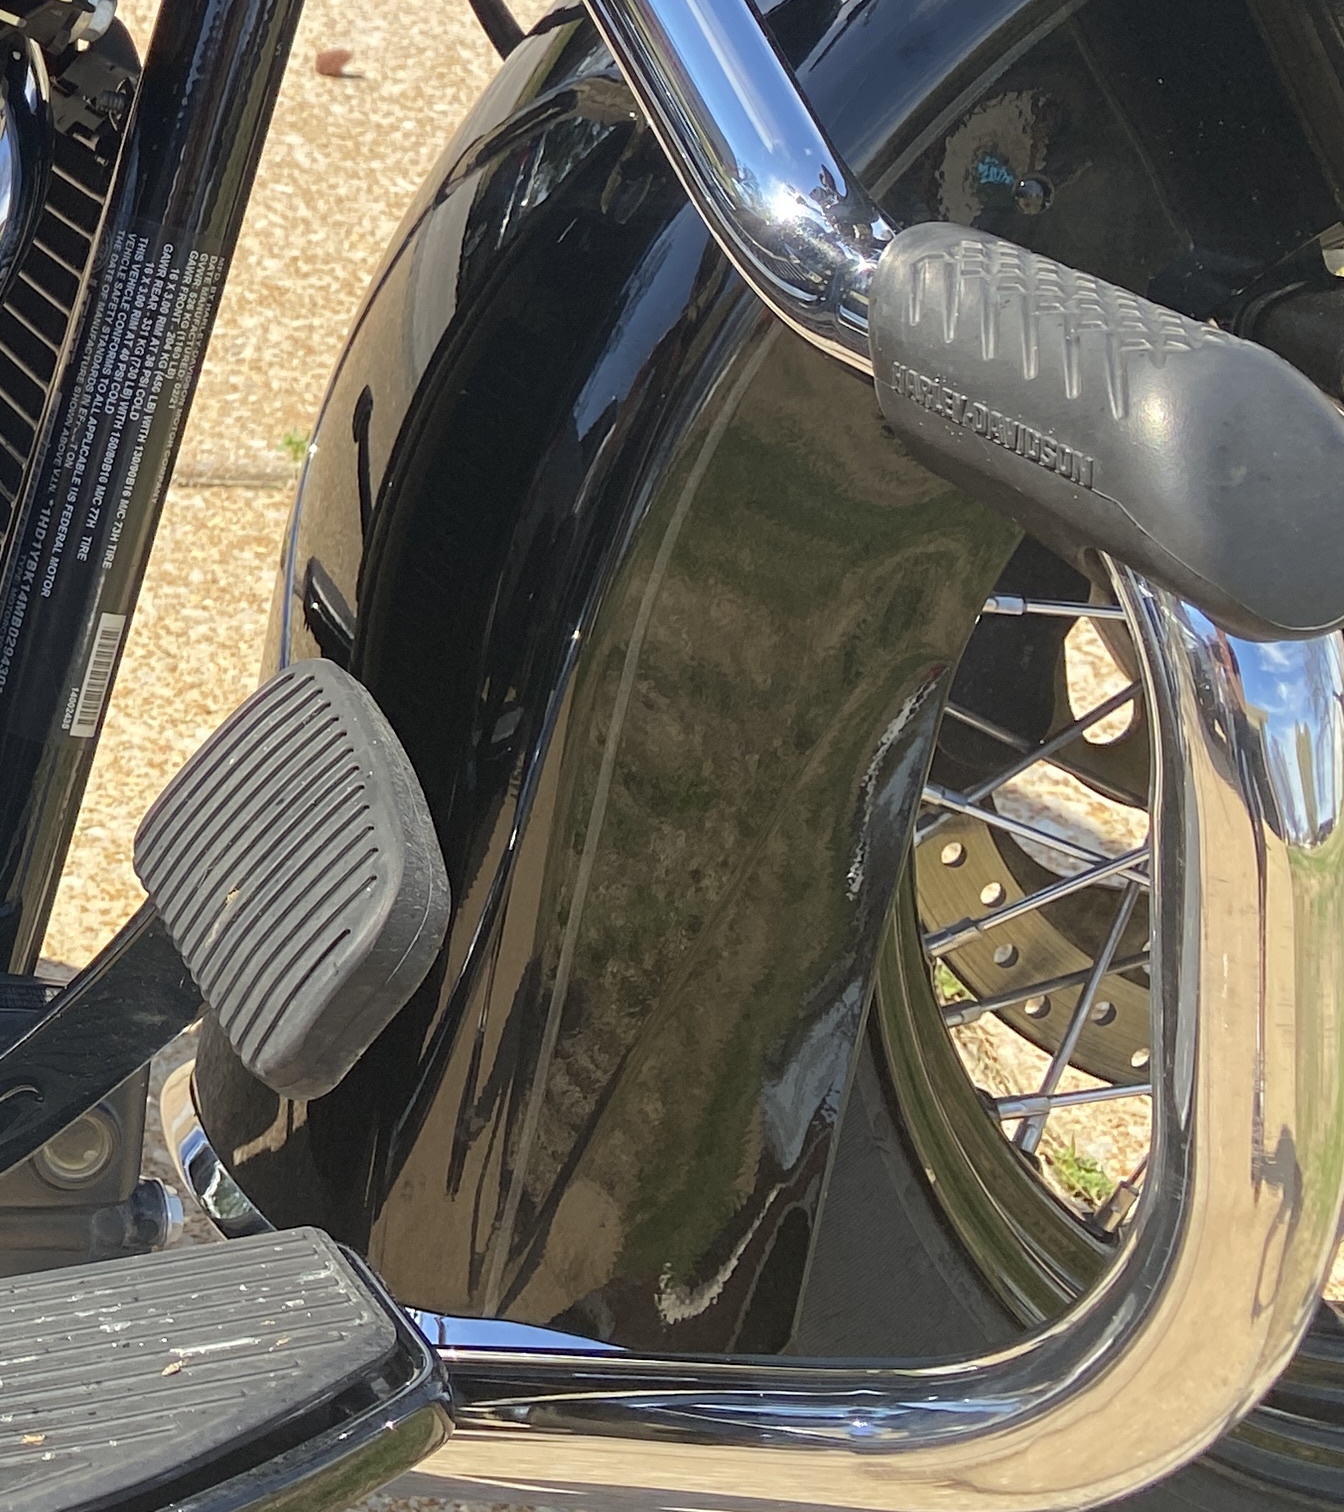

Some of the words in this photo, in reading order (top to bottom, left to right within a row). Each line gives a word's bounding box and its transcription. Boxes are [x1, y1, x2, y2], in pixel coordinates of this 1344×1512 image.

[112, 229, 126, 252] THE
[133, 235, 149, 262] THIS
[104, 253, 119, 283] DATE
[116, 232, 137, 280] VEHICLE
[143, 261, 155, 275] 16
[156, 243, 174, 279] GAWR
[182, 250, 199, 285] GAWR
[141, 275, 151, 285] X
[168, 267, 180, 281] 16
[191, 252, 209, 290] GVWR:
[203, 255, 218, 284] DATE
[99, 284, 111, 301] OF
[120, 262, 141, 311] VEHICLE
[134, 285, 148, 309] 3.00
[147, 279, 164, 311] REAR
[165, 281, 176, 291] X
[104, 280, 124, 325] SAFETY
[159, 291, 173, 315] 3.00
[171, 286, 189, 325] FRONT
[185, 291, 198, 311] 526
[127, 309, 142, 331] RIM
[139, 317, 153, 337] 331
[153, 315, 167, 337] RIM
[180, 312, 192, 330] KG
[76, 301, 106, 384] MANUFACTURE
[102, 311, 128, 376] CONFORMS
[123, 330, 136, 348] AT
[148, 337, 161, 354] AT
[163, 331, 176, 351] 204
[170, 330, 187, 360] (1160
[176, 286, 209, 382] MANUFACTURED:
[85, 324, 111, 393] STANDARDS
[119, 347, 131, 362] 40
[134, 338, 147, 356] KG
[113, 362, 127, 382] PSI
[125, 356, 142, 381] (730
[144, 354, 156, 368] 38
[158, 352, 170, 370] KG
[164, 360, 178, 380] LB)
[97, 376, 109, 394] TO
[119, 380, 135, 400] LB)
[138, 368, 152, 388] PSI
[149, 370, 165, 394] (450
[64, 385, 82, 427] SHOWN
[81, 393, 92, 406] IN
[90, 393, 104, 416] ALL
[104, 381, 121, 415] COLD
[129, 388, 146, 422] COLD
[143, 394, 158, 414] LB)
[168, 382, 182, 410] 02/21
[113, 400, 130, 430] WITH
[137, 414, 153, 444] WITH
[53, 427, 71, 467] ABOVE
[71, 416, 98, 485] APPLICABLE
[97, 430, 121, 484] 150/80B16
[63, 451, 76, 469] ON
[122, 444, 144, 498] 130/90B16
[66, 486, 79, 503] US
[91, 484, 106, 506] M/C
[85, 507, 100, 529] 77H
[115, 498, 129, 520] M/C
[52, 503, 74, 555] FEDERAL
[109, 520, 123, 543] 73H
[76, 535, 92, 562] TIRE
[101, 544, 117, 570] TIRE
[40, 556, 59, 598] MOTOR
[61, 686, 80, 730] 14002435
